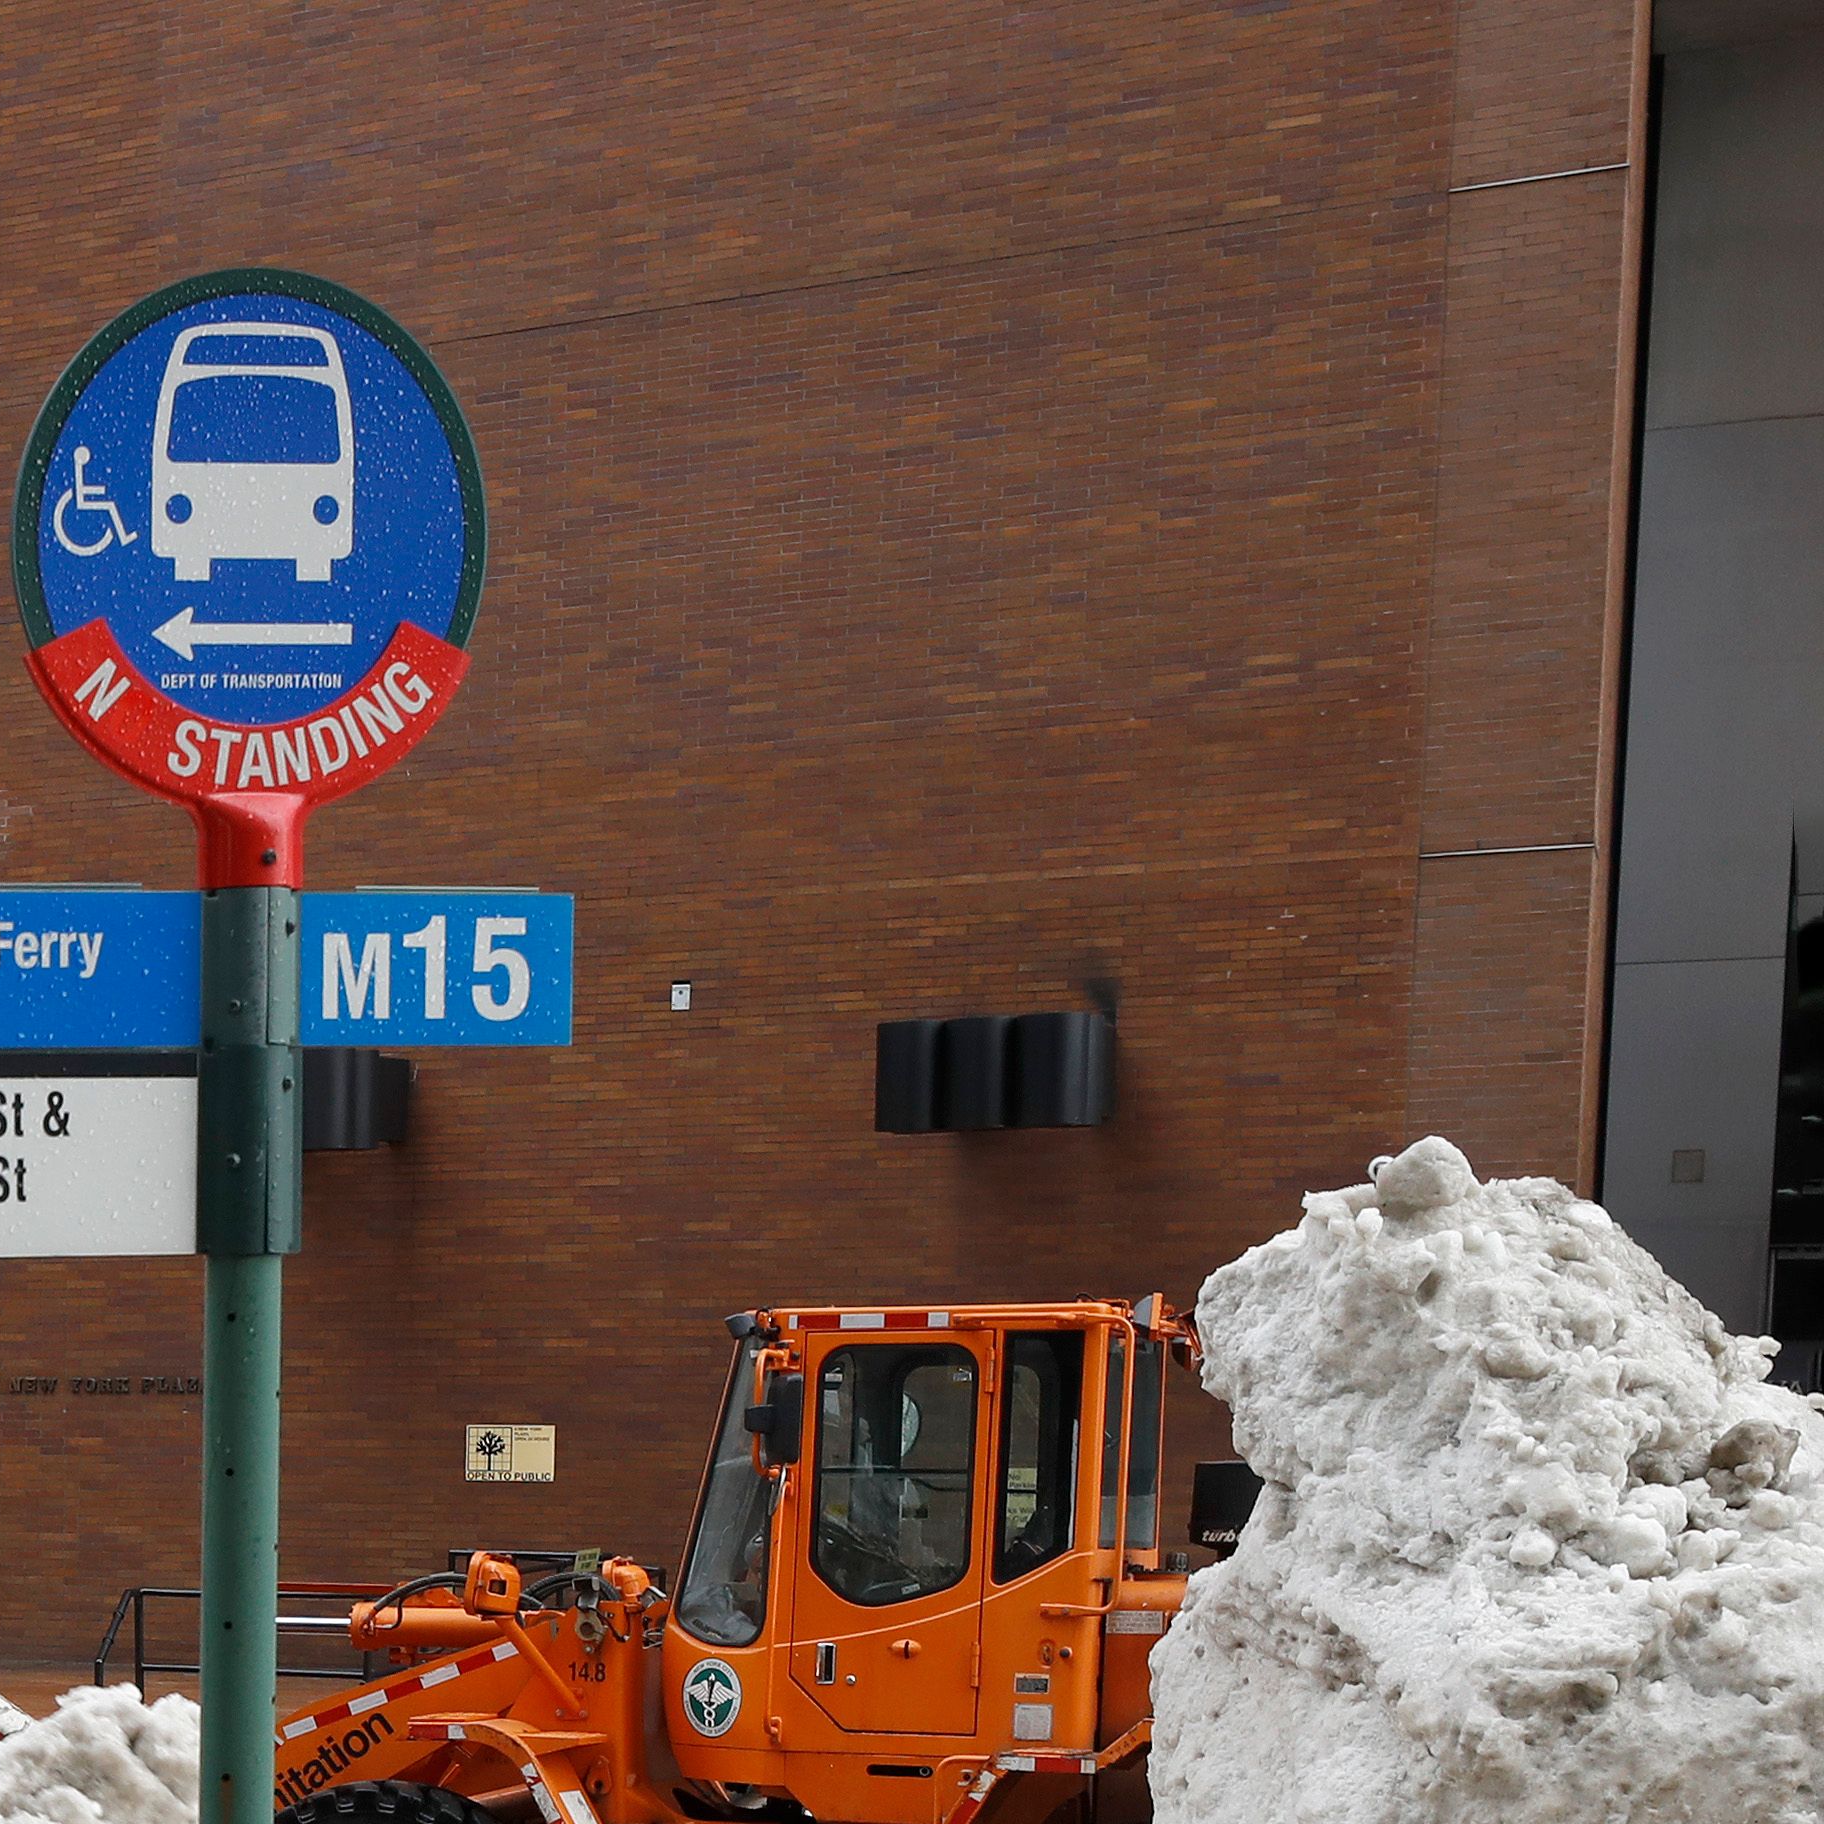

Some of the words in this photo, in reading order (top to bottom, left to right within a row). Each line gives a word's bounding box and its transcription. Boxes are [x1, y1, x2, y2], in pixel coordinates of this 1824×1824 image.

[161, 673, 195, 689] DEPT
[201, 673, 217, 689] OF
[222, 673, 342, 689] TRANSPORTATION
[167, 661, 434, 789] STANDING
[321, 915, 531, 1021] M15
[42, 1091, 70, 1136] &
[8, 1376, 58, 1395] NEW
[71, 1376, 130, 1395] YORK
[141, 1376, 203, 1395] PLAZ
[467, 1472, 495, 1480] OPEN
[499, 1472, 512, 1480] TO
[514, 1472, 552, 1481] PUBLIC
[568, 1661, 607, 1682] 14.8
